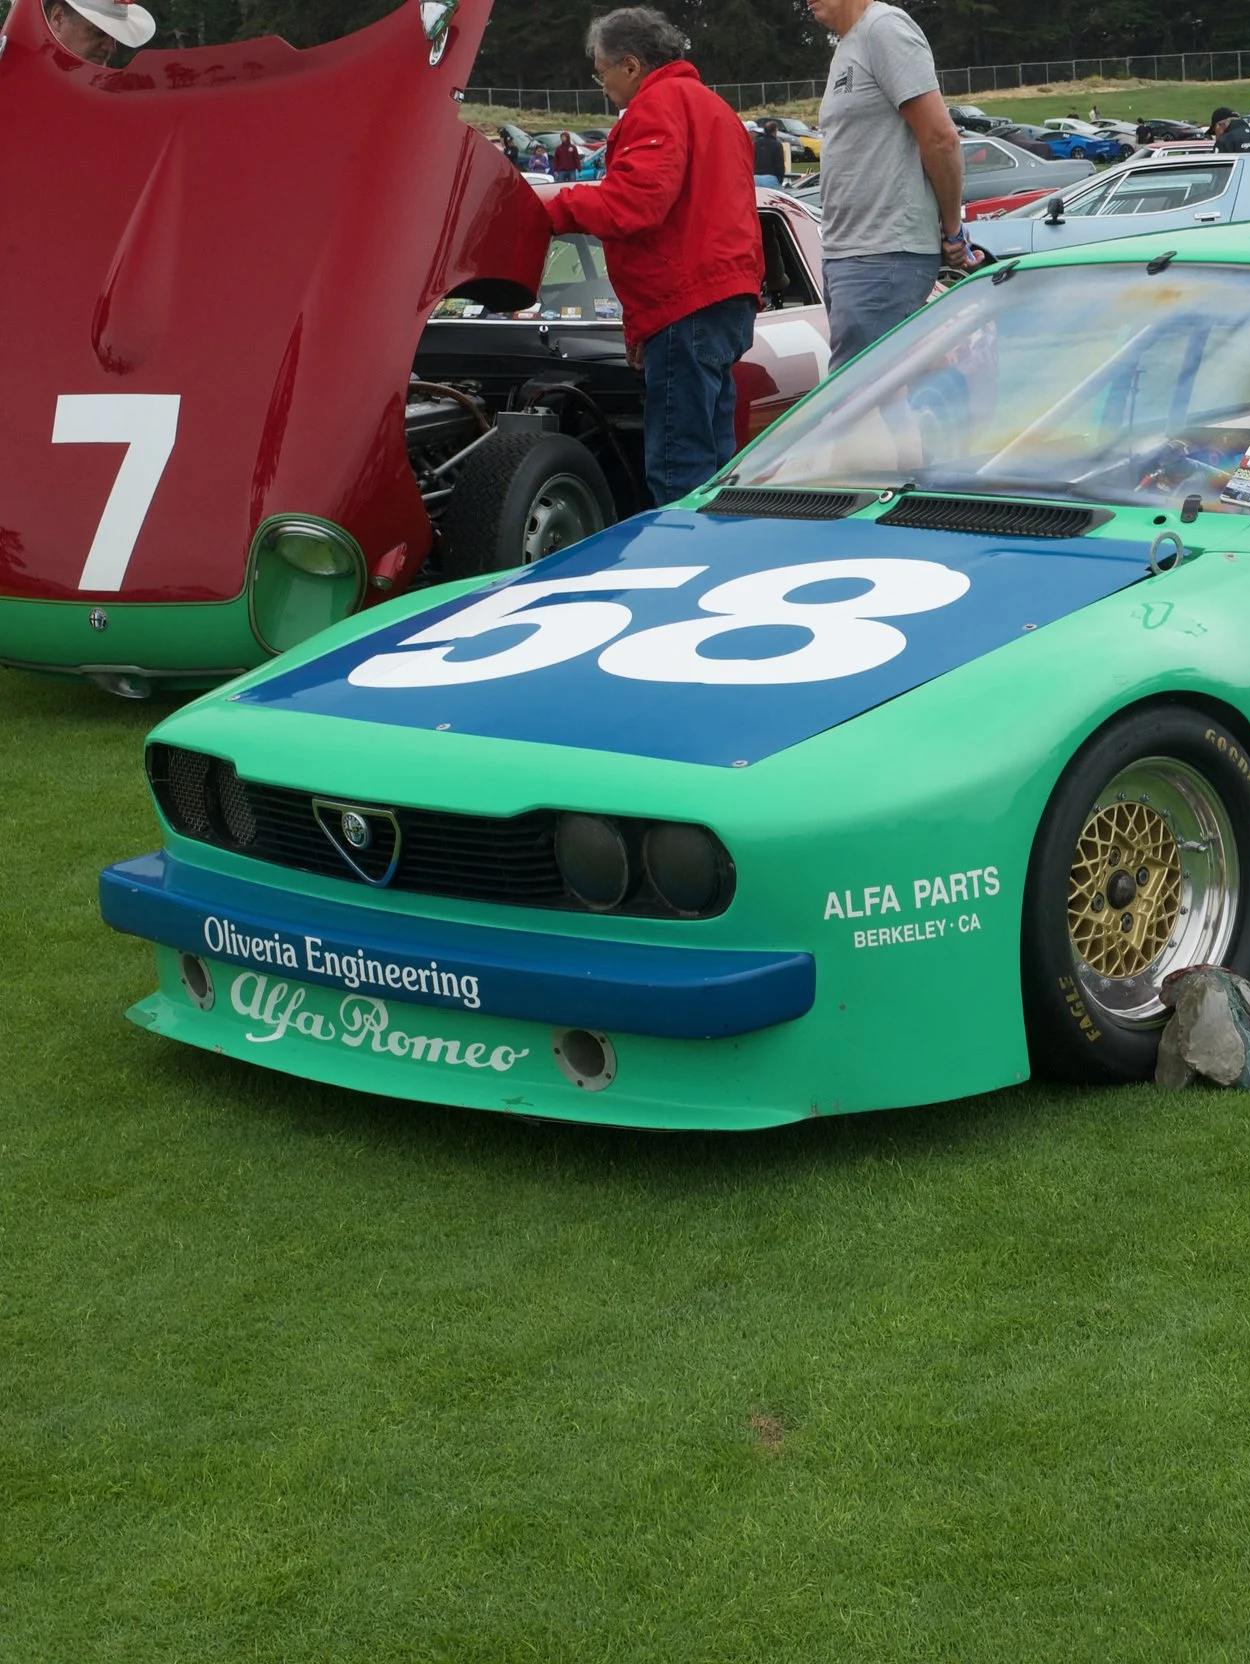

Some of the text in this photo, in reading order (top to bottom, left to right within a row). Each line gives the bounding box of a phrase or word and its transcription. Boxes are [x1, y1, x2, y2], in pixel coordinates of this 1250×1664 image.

[52, 393, 182, 592] 7
[347, 558, 971, 688] 58
[823, 865, 1001, 920] ALFA PARTS
[203, 916, 482, 1009] Oliveria Engineering
[1059, 974, 1102, 1042] EAGLE
[230, 971, 530, 1072] Alfa Romeo
